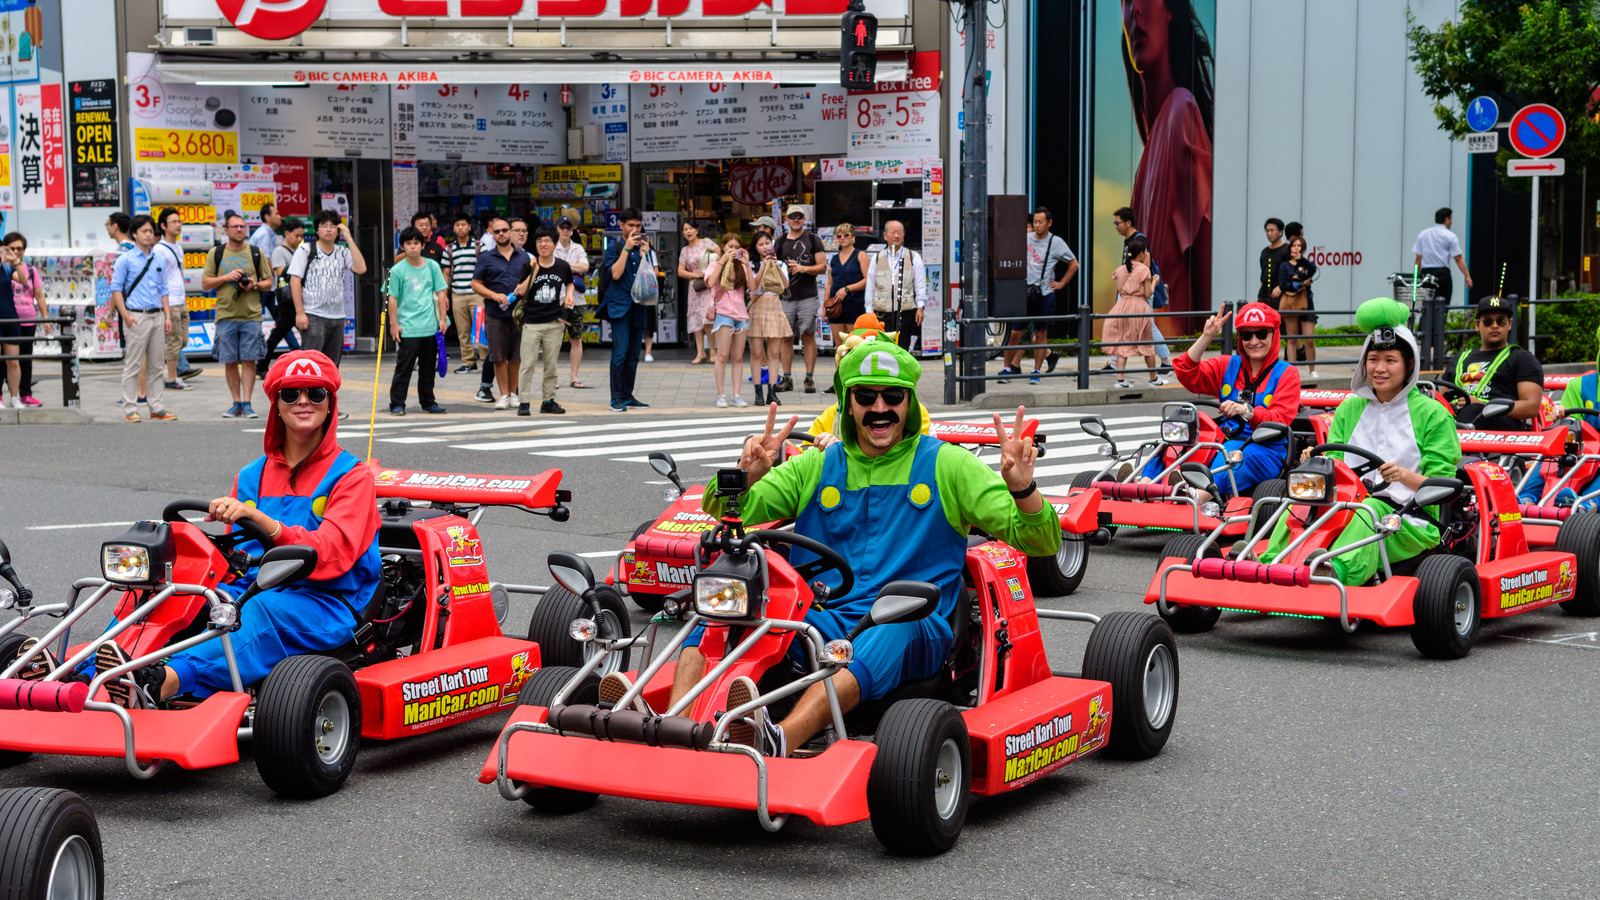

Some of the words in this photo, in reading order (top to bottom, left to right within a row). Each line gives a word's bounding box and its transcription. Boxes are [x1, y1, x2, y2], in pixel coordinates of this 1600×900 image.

[308, 72, 329, 81] BIC
[333, 72, 389, 81] CAMERA
[398, 72, 438, 81] AKIBA
[643, 71, 664, 81] BIC
[673, 71, 723, 81] CAMERA
[732, 71, 773, 80] AKIBA
[875, 80, 897, 91] Tax
[901, 76, 932, 90] Free
[822, 94, 844, 104] Free
[76, 111, 111, 123] RENEWAL
[165, 103, 203, 118] Google
[821, 107, 847, 120] Wi-Fi
[857, 97, 871, 128] 8
[896, 96, 909, 127] 5
[166, 119, 188, 127] Home
[190, 119, 206, 128] Mini
[76, 124, 112, 143] OPEN
[20, 112, 42, 195] 決算
[77, 145, 113, 163] SALE
[741, 167, 787, 201] KitKat
[1307, 246, 1362, 266] docomo
[1246, 311, 1264, 322] M
[290, 362, 317, 376] M
[871, 354, 889, 375] L
[403, 472, 532, 490] MariCar.com
[1500, 575, 1521, 592] Street
[1520, 570, 1534, 587] Kart
[1534, 569, 1548, 583] Tour
[1500, 584, 1553, 609] MariCar.com
[402, 681, 440, 702] Street
[439, 670, 464, 693] Kart
[463, 665, 489, 687] Tour
[403, 684, 499, 727] MariCar.com
[1005, 728, 1035, 757] Street
[1034, 722, 1054, 746] Kart
[1053, 712, 1072, 738] Tour
[1004, 733, 1079, 784] MariCar.com
